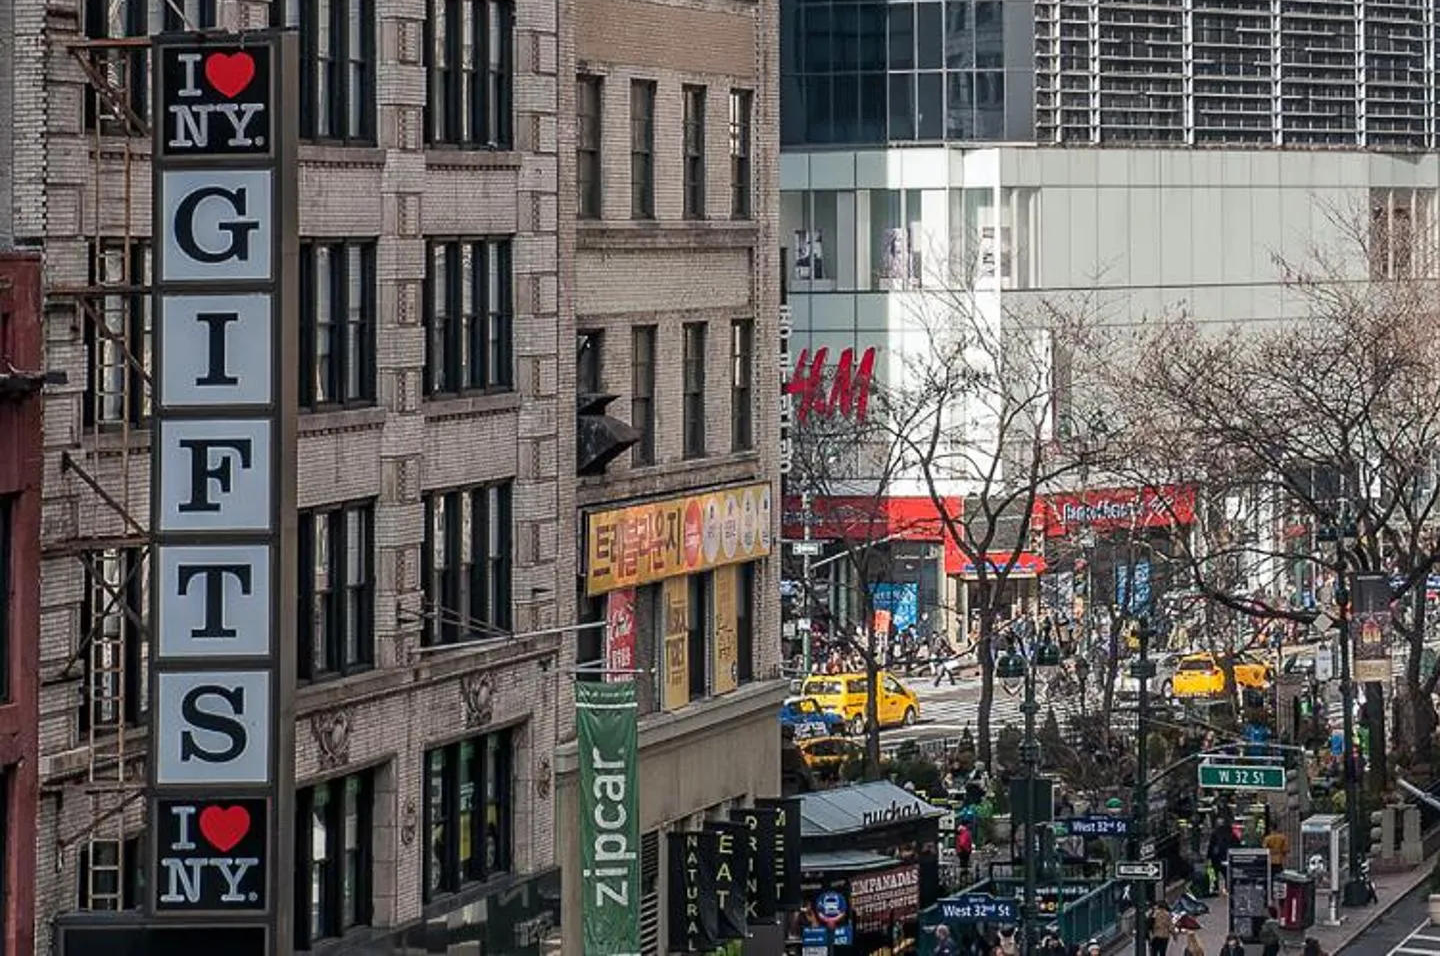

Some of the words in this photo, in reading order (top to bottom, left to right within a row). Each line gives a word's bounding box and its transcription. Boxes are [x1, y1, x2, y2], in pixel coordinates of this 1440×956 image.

[178, 53, 202, 96] I
[786, 346, 876, 425] H&M
[174, 186, 259, 763] GIFTS
[1218, 770, 1229, 782] W
[1235, 771, 1248, 783] 32
[1253, 772, 1265, 785] St
[171, 806, 196, 850] I
[583, 747, 636, 906] zipcar
[1116, 821, 1126, 833] St
[686, 836, 698, 952] NATURAL
[716, 834, 732, 910] EAT
[851, 869, 919, 895] EMPANADAS
[942, 905, 971, 917] West
[998, 904, 1010, 917] St
